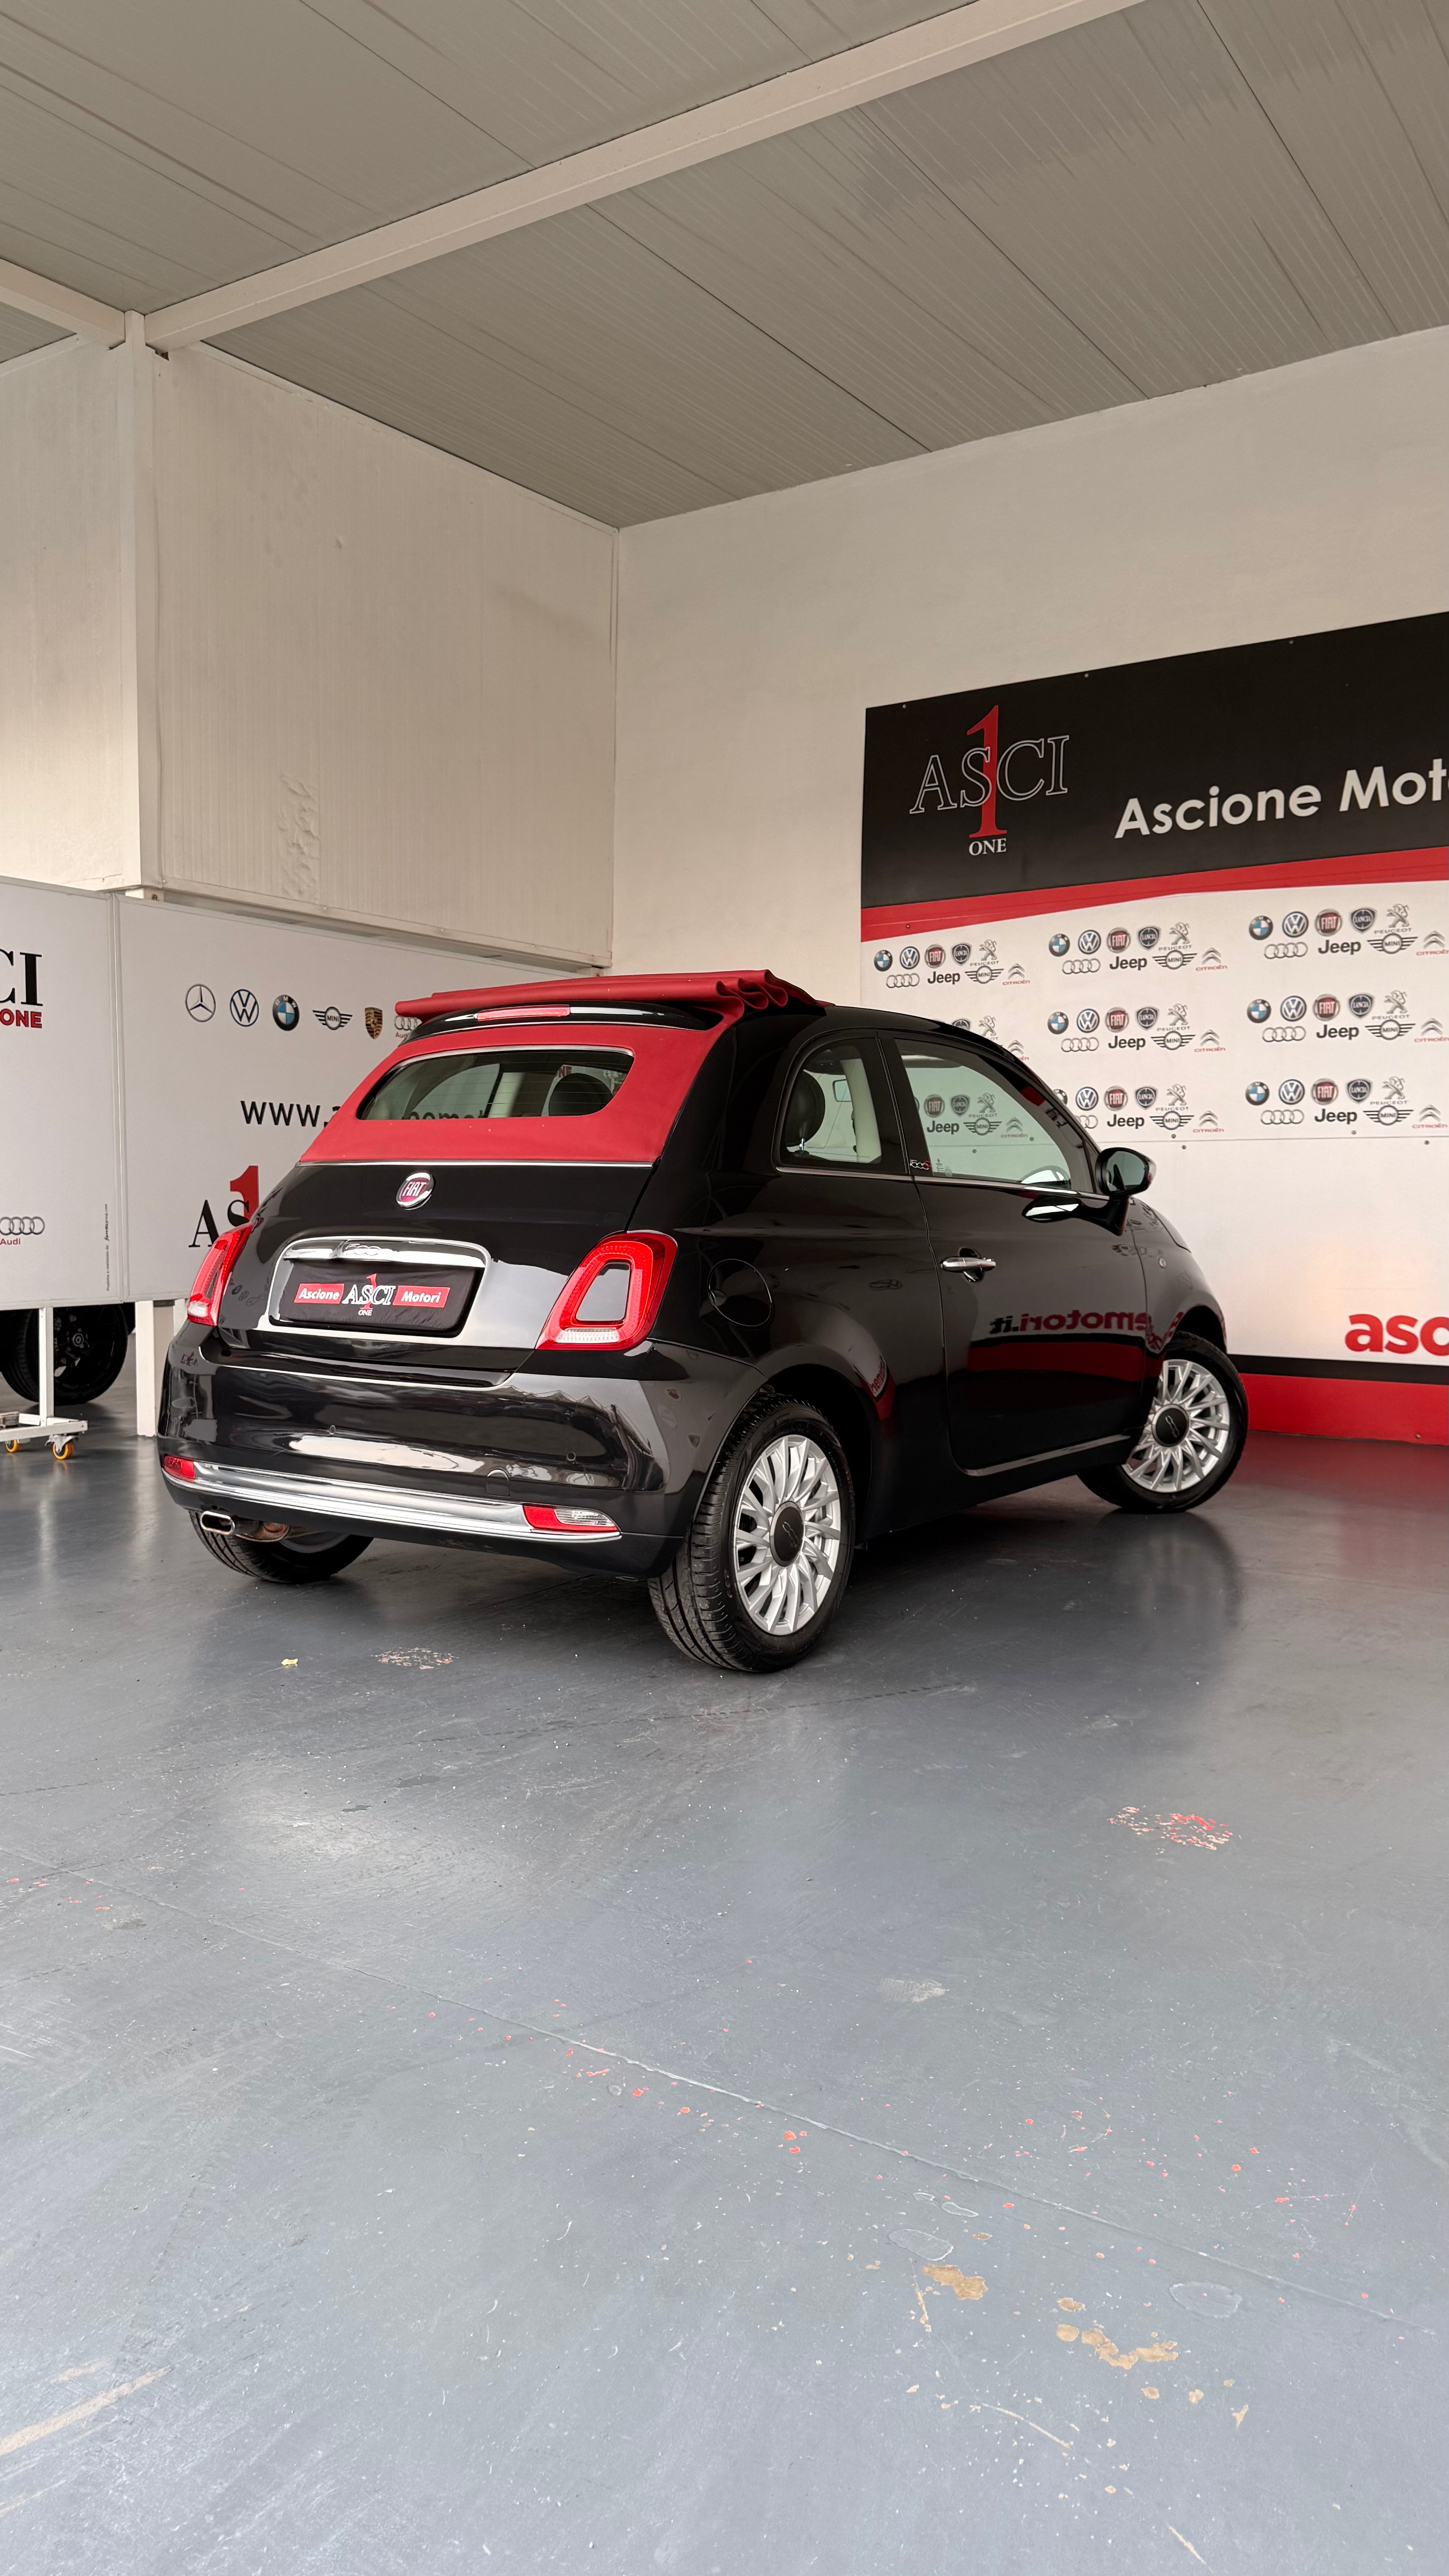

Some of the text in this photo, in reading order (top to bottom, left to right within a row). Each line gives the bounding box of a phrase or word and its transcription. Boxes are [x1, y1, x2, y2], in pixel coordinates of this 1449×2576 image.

[909, 735, 1069, 814] ASCI
[1115, 759, 1449, 839] Ascione Mot
[969, 838, 1007, 856] ONE
[1321, 916, 1337, 929] FIAT
[1112, 934, 1126, 947] FIAT
[1318, 940, 1361, 955] Jeep
[929, 951, 941, 963] FIAT
[1109, 956, 1147, 971] Jeep
[927, 971, 960, 984] Jeep
[1319, 1002, 1335, 1014] FIAT
[1111, 1014, 1124, 1026] FIAT
[1316, 1025, 1359, 1040] Jeep
[1109, 1036, 1146, 1050] Jeep
[1109, 1093, 1123, 1104] FIAT
[1317, 1086, 1333, 1098] FIAT
[928, 1101, 941, 1112] FIAT
[1107, 1114, 1145, 1128] Jeep
[1315, 1109, 1357, 1124] Jeep
[927, 1121, 959, 1135] Jeep
[402, 1182, 427, 1196] FIAT
[298, 1284, 442, 1305] Ascione ASCI Motori
